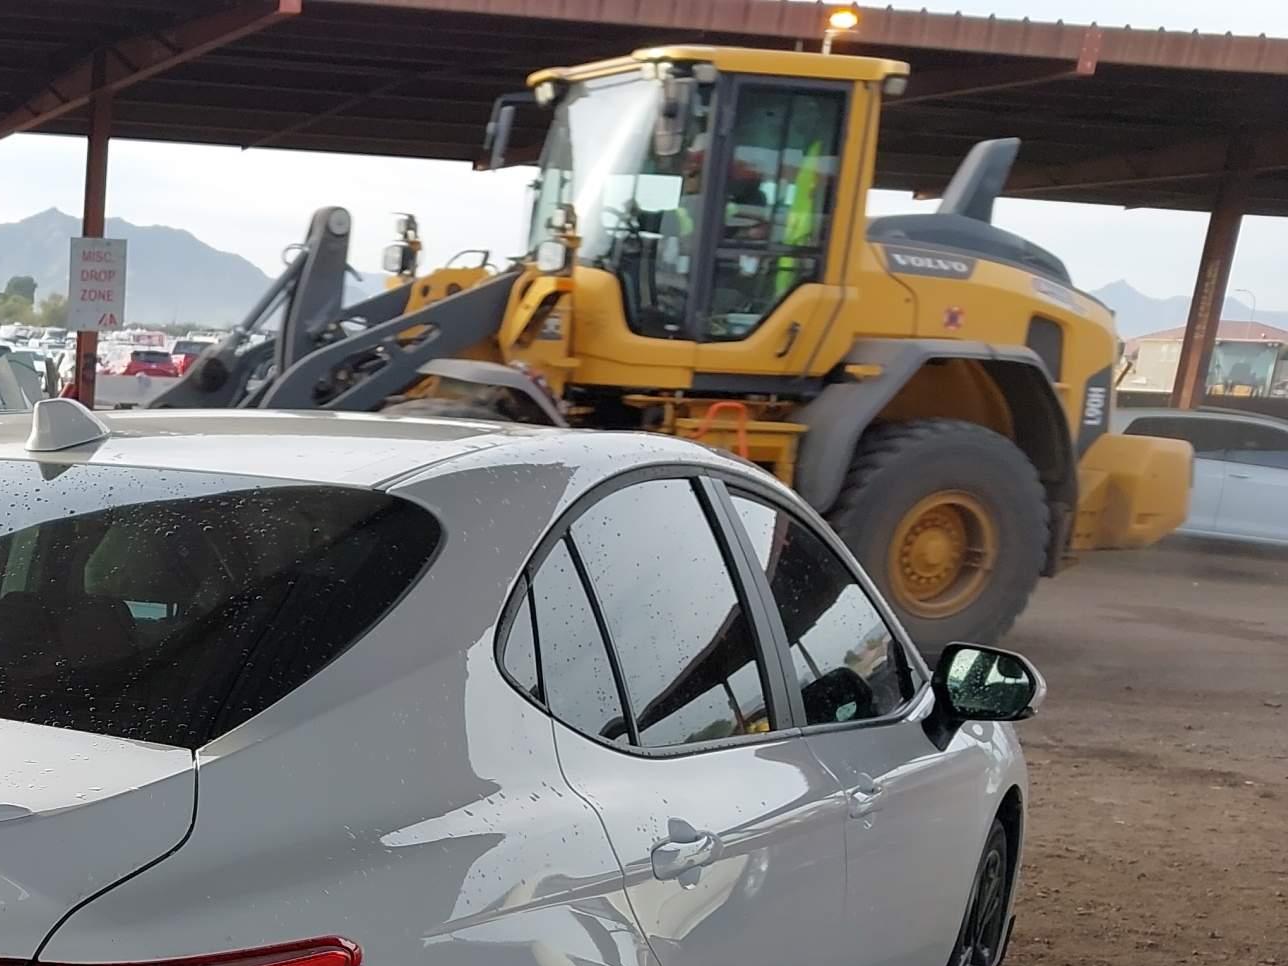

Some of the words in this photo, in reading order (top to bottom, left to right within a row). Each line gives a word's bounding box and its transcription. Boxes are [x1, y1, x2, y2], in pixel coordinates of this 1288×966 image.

[892, 253, 969, 273] VOLVO
[81, 270, 116, 282] DROP
[80, 289, 113, 302] ZONE
[1083, 387, 1106, 426] L90H
